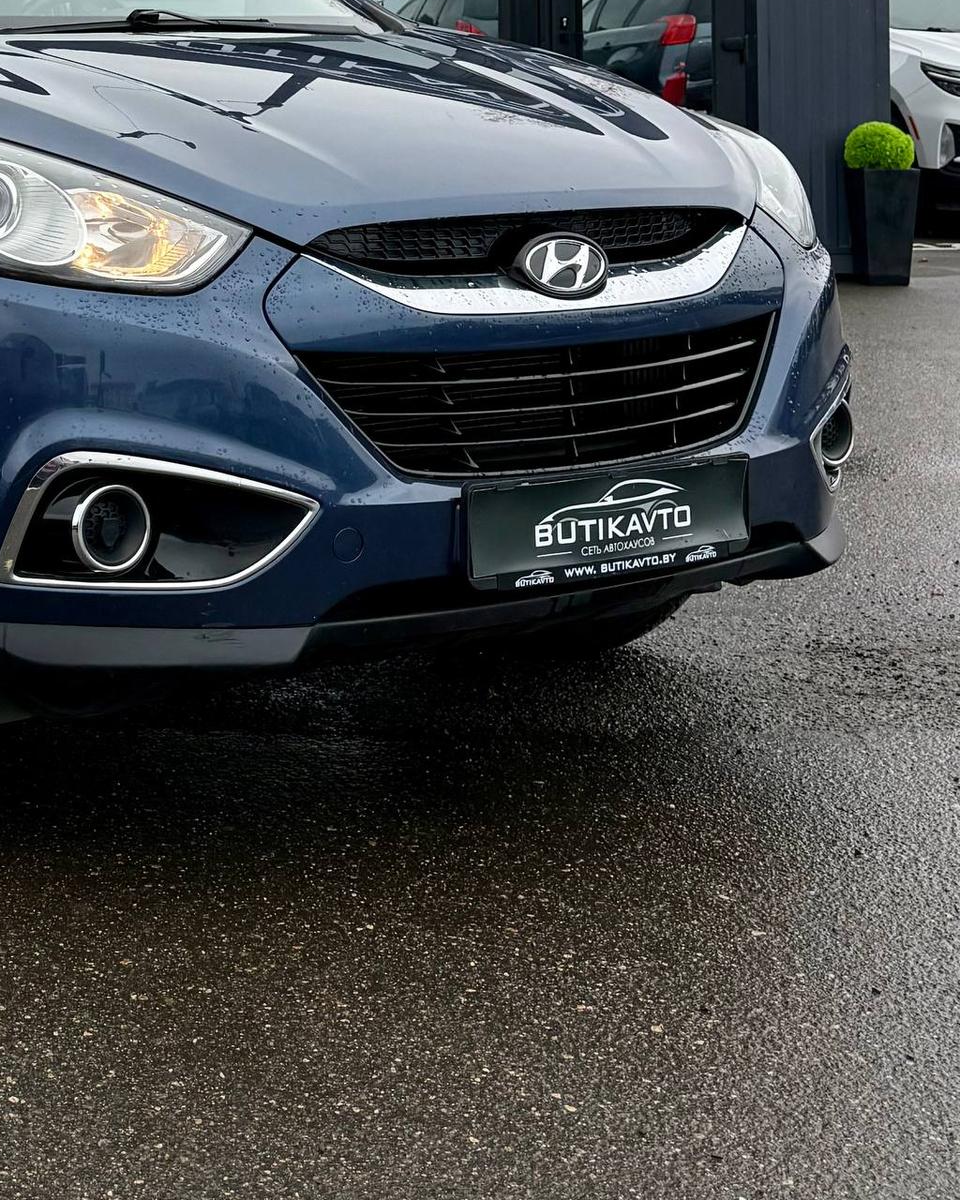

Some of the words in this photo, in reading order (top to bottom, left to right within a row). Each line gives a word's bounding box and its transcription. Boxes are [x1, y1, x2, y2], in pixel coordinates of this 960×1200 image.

[534, 504, 691, 548] BUTIKAVTO
[580, 545, 602, 557] СЕТЬ
[603, 536, 656, 554] АВТОХАУСОВ
[515, 576, 554, 588] BUTIKAVTO
[564, 564, 597, 578] WWW.
[600, 553, 677, 574] BUTIKAVTO.BY
[685, 550, 717, 563] BUTIKAVTO
